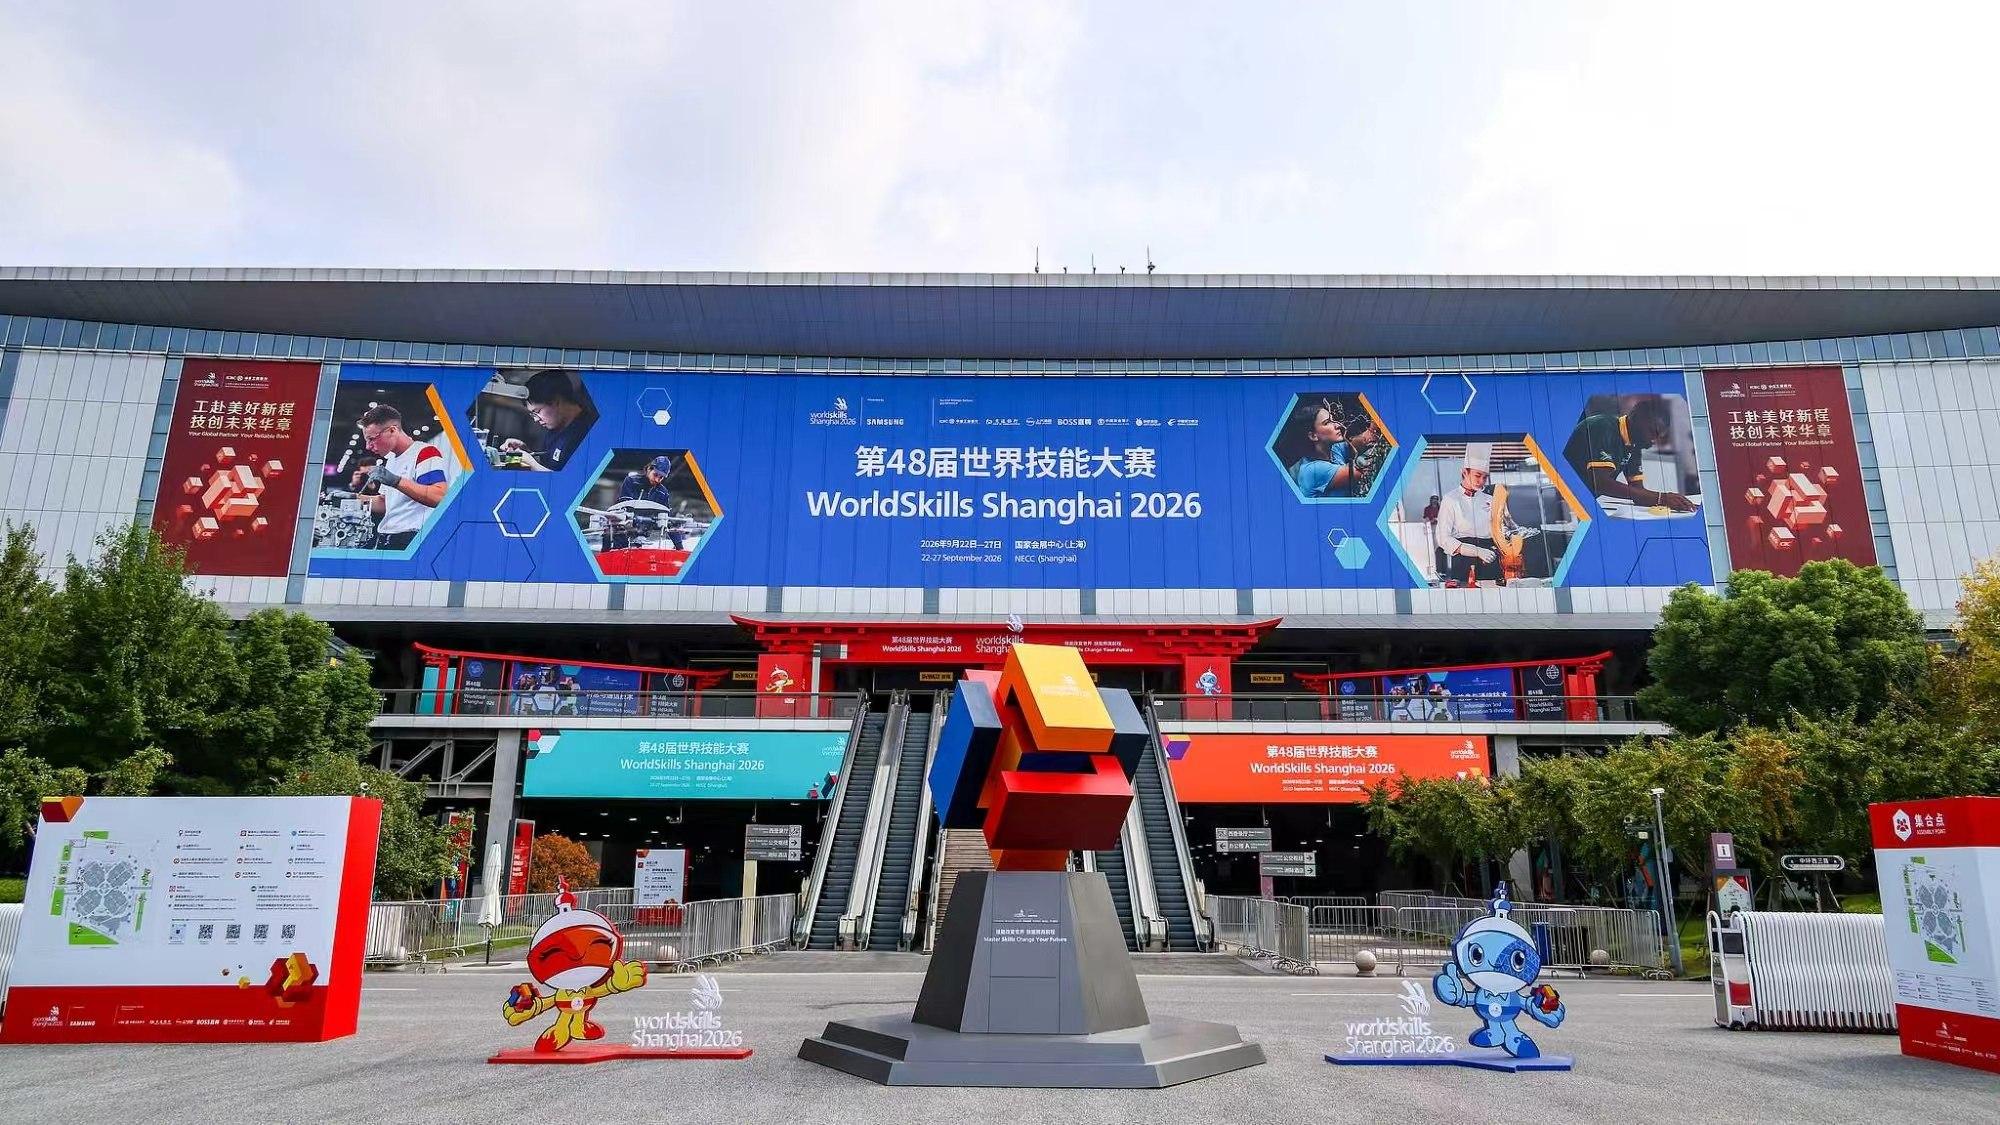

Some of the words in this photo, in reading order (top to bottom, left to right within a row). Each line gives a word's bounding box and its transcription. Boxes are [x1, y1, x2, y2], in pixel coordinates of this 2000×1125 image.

[192, 400, 295, 416] 工赴美好新程
[809, 409, 848, 419] worldskills
[190, 414, 292, 431] 技创未来华章
[866, 418, 904, 426] SAMSUNG
[1728, 408, 1830, 424] 工赴美好新程
[1730, 424, 1832, 440] 技创未来华章
[854, 446, 1158, 479] 第48届世界技能大赛
[807, 490, 973, 518] WorldSkills
[982, 490, 1121, 525] Shanghai
[1130, 492, 1202, 518] 2026
[921, 554, 942, 562] 22-27
[942, 554, 982, 563] September
[984, 554, 1002, 563] 2026
[1038, 554, 1077, 563] (Shanghai)
[892, 636, 953, 644] 第48届世界技能大赛
[976, 635, 1024, 645] worldskills
[917, 645, 946, 654] Shanghai
[638, 741, 750, 755] 第48届世界技能大赛
[1266, 745, 1378, 759] 第48届世界技能大赛
[620, 758, 681, 770] WorldSkills
[684, 758, 735, 773] Shanghai
[737, 760, 765, 770] 2026
[1250, 762, 1312, 773] WorldSkills
[1314, 762, 1366, 775] Shanghai
[1368, 763, 1395, 774] 2026
[1914, 812, 1945, 828] 集合点
[634, 1011, 722, 1029] worldskills
[1344, 1016, 1433, 1036] worldskills
[631, 1029, 743, 1052] Shanghai2026
[1344, 1035, 1455, 1058] Shanghai2026
